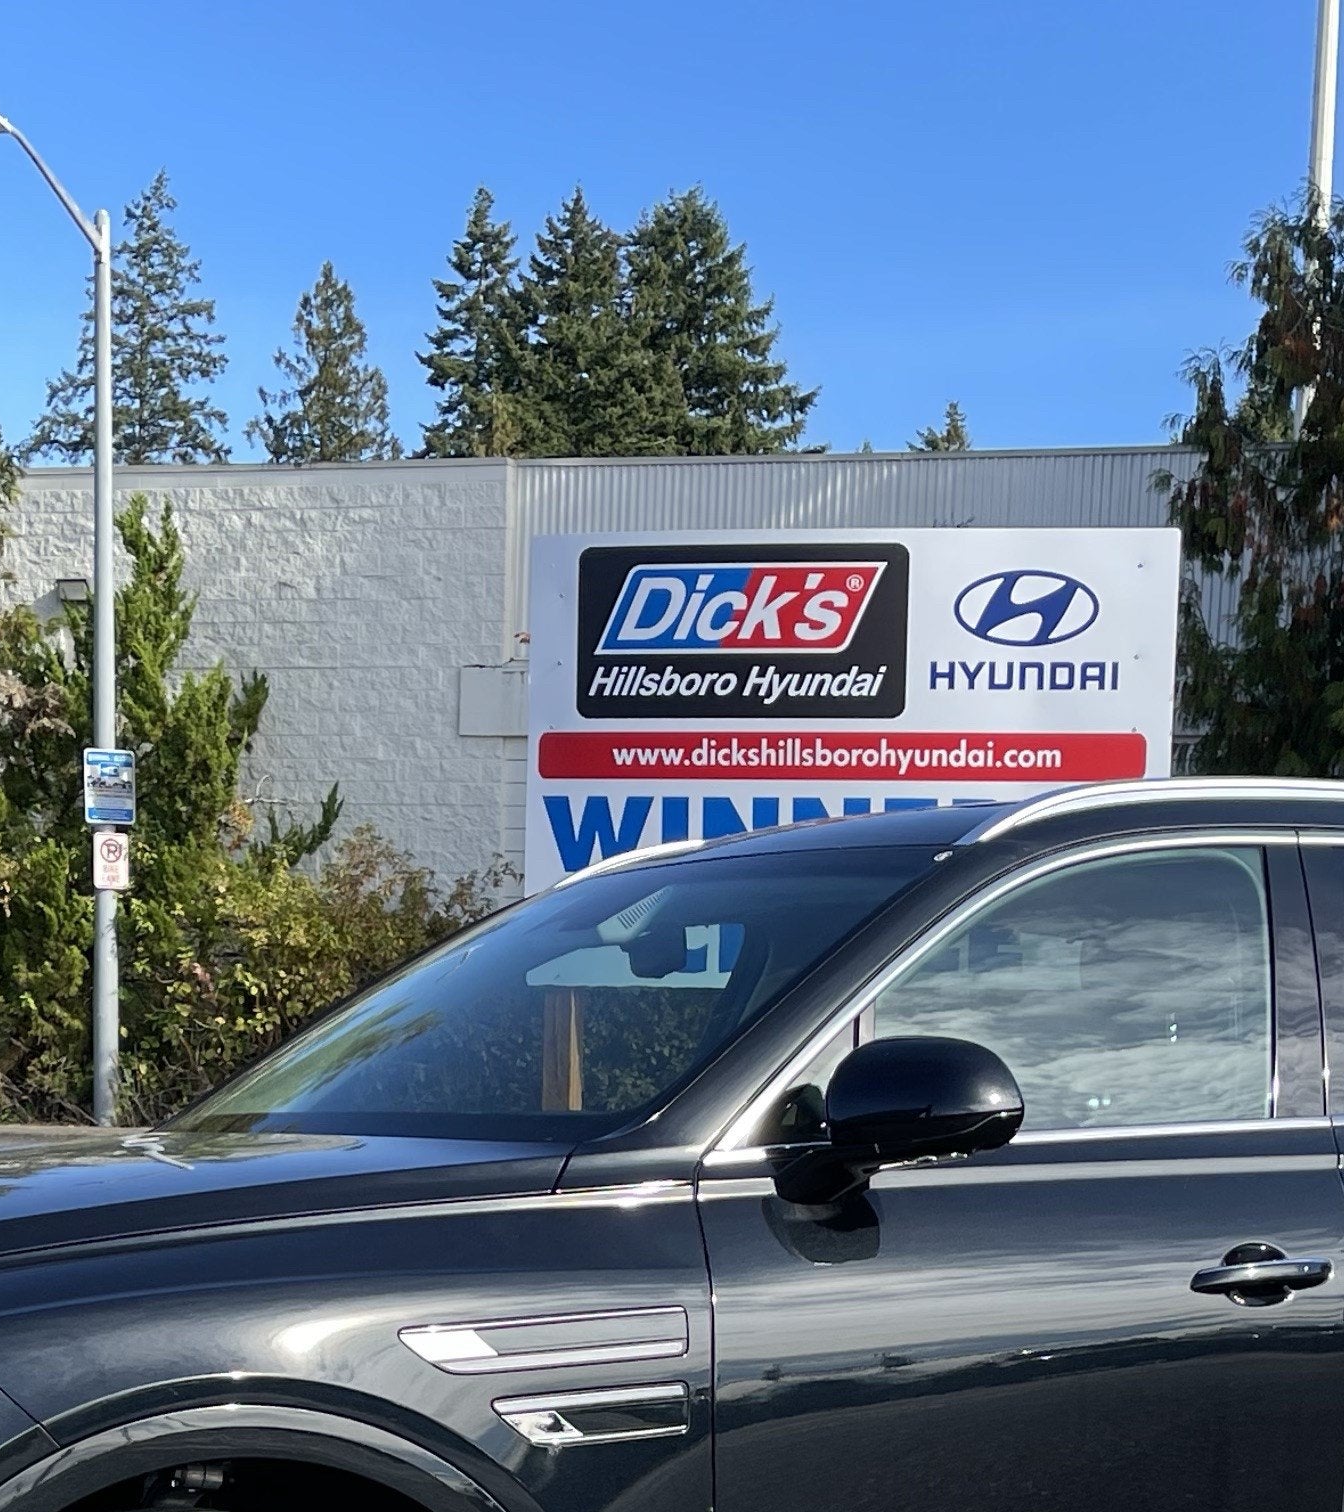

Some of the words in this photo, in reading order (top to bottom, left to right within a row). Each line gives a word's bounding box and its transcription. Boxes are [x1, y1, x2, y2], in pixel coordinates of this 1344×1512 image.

[589, 666, 738, 697] Hillsboro
[742, 665, 887, 705] Hyundai
[929, 660, 1119, 691] HYUNDAI
[612, 739, 1062, 775] www.dickshillsborohyundai.com
